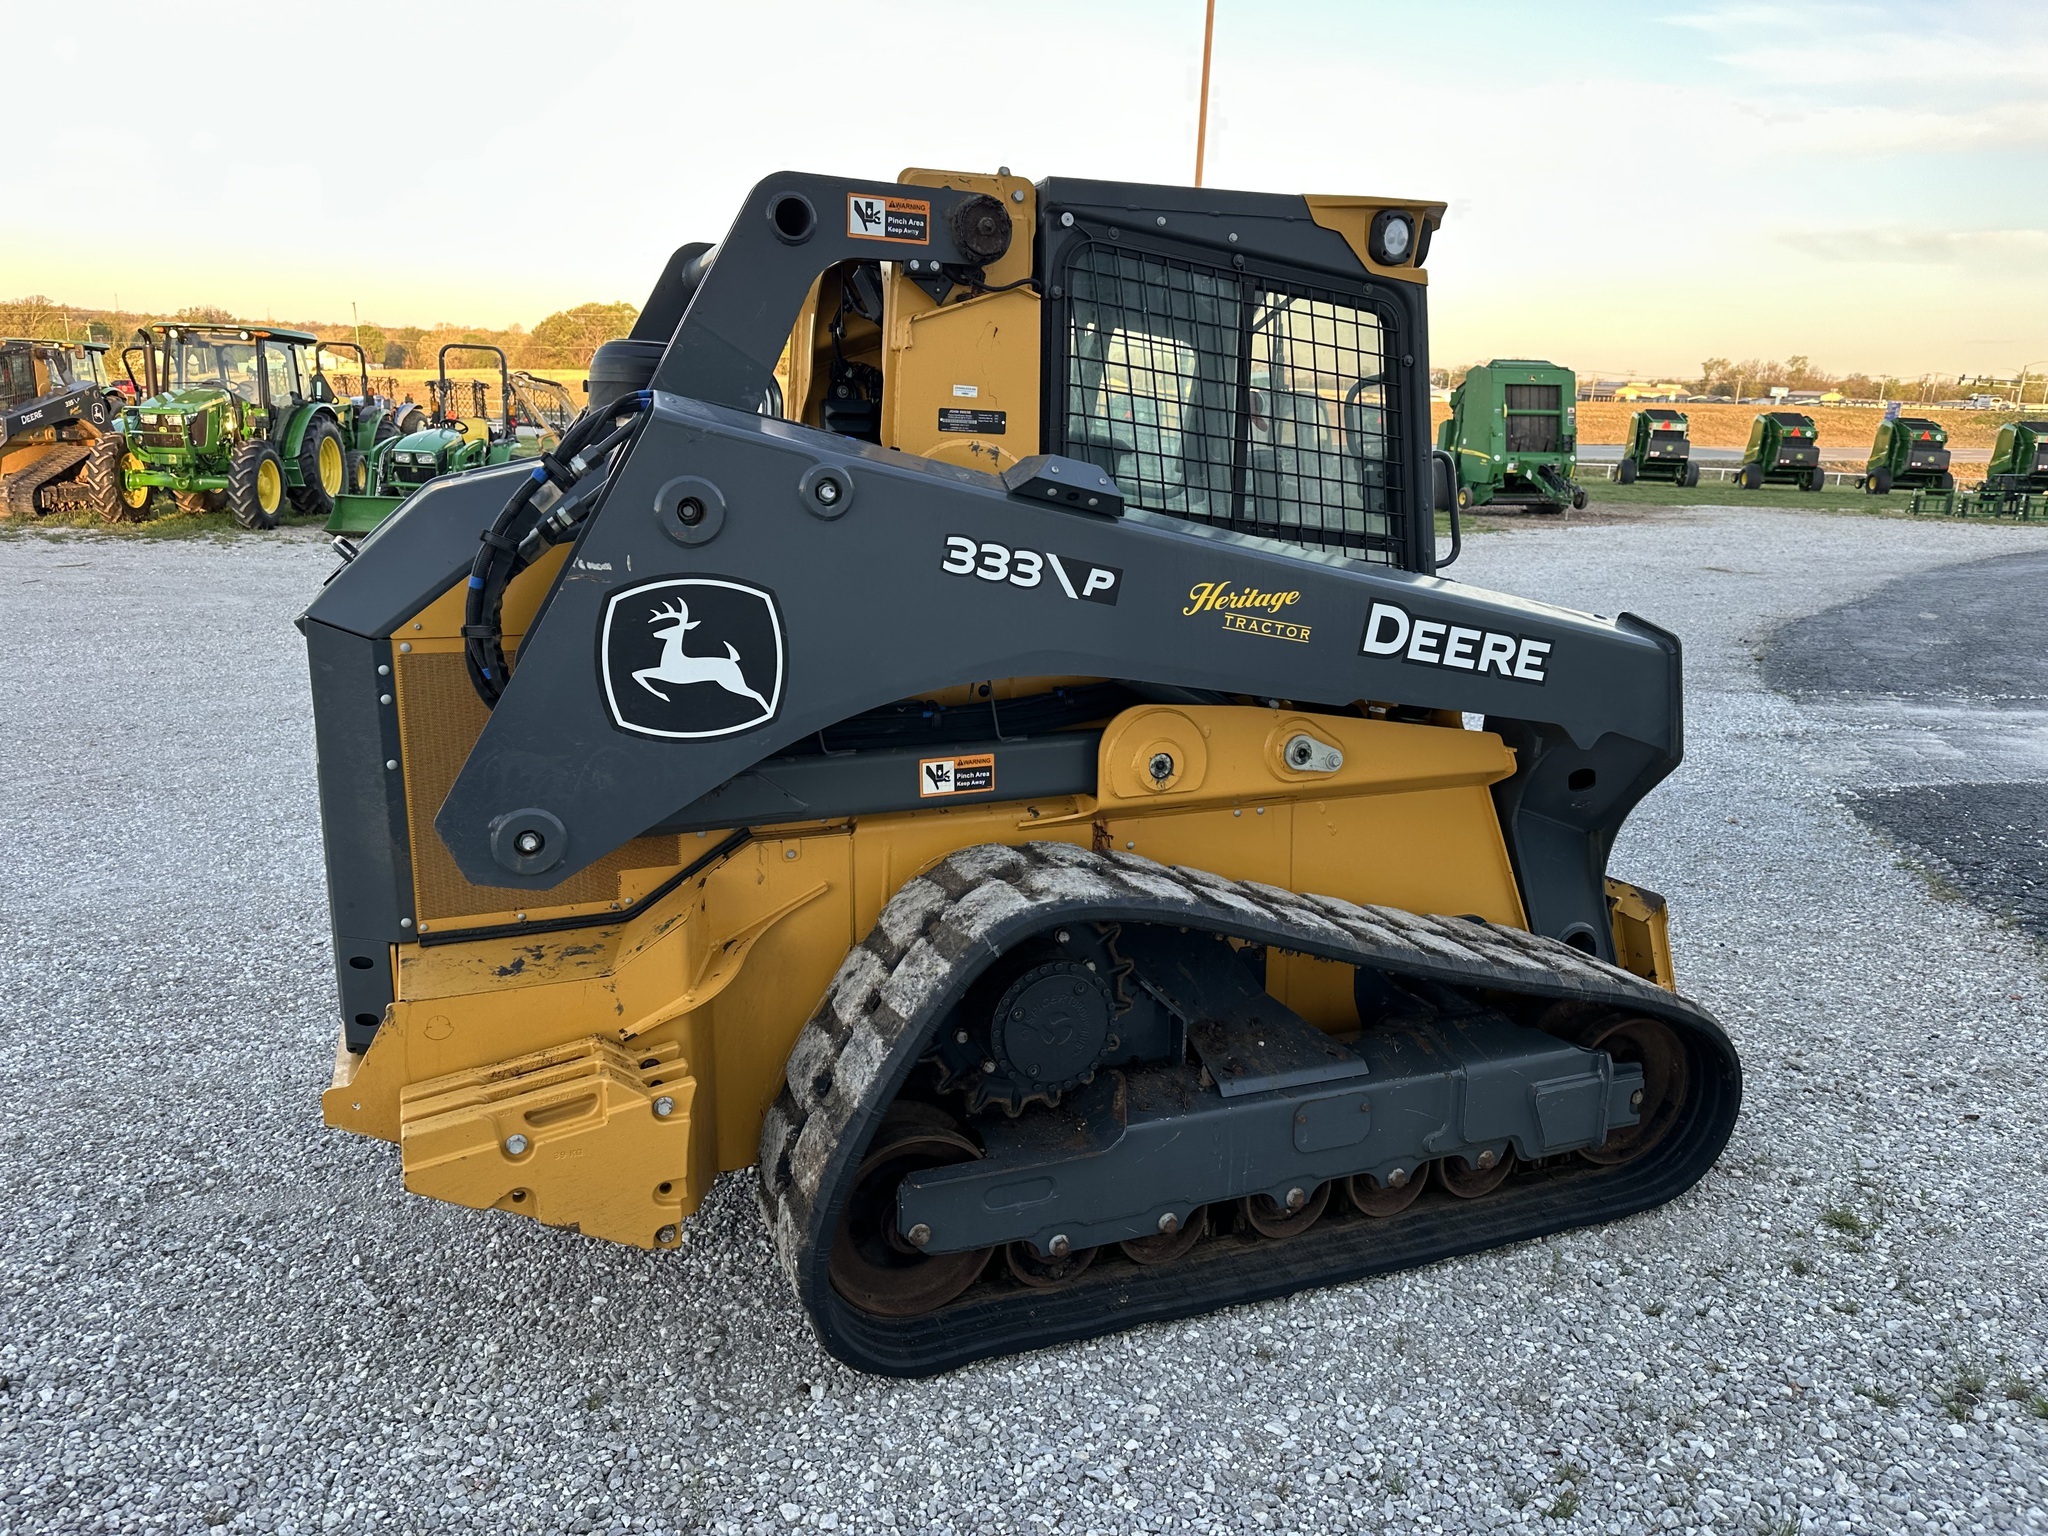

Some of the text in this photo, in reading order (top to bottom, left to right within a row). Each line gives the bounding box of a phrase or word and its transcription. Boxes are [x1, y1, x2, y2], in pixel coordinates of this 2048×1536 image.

[896, 202, 926, 211] WARNING
[888, 216, 924, 226] Pinch Area
[20, 410, 44, 424] DEERE
[1182, 580, 1302, 616] Heritage
[1224, 614, 1311, 640] TRACTOR
[1362, 602, 1552, 682] DEERE
[964, 758, 991, 766] WARNING
[569, 1148, 583, 1160] KG
